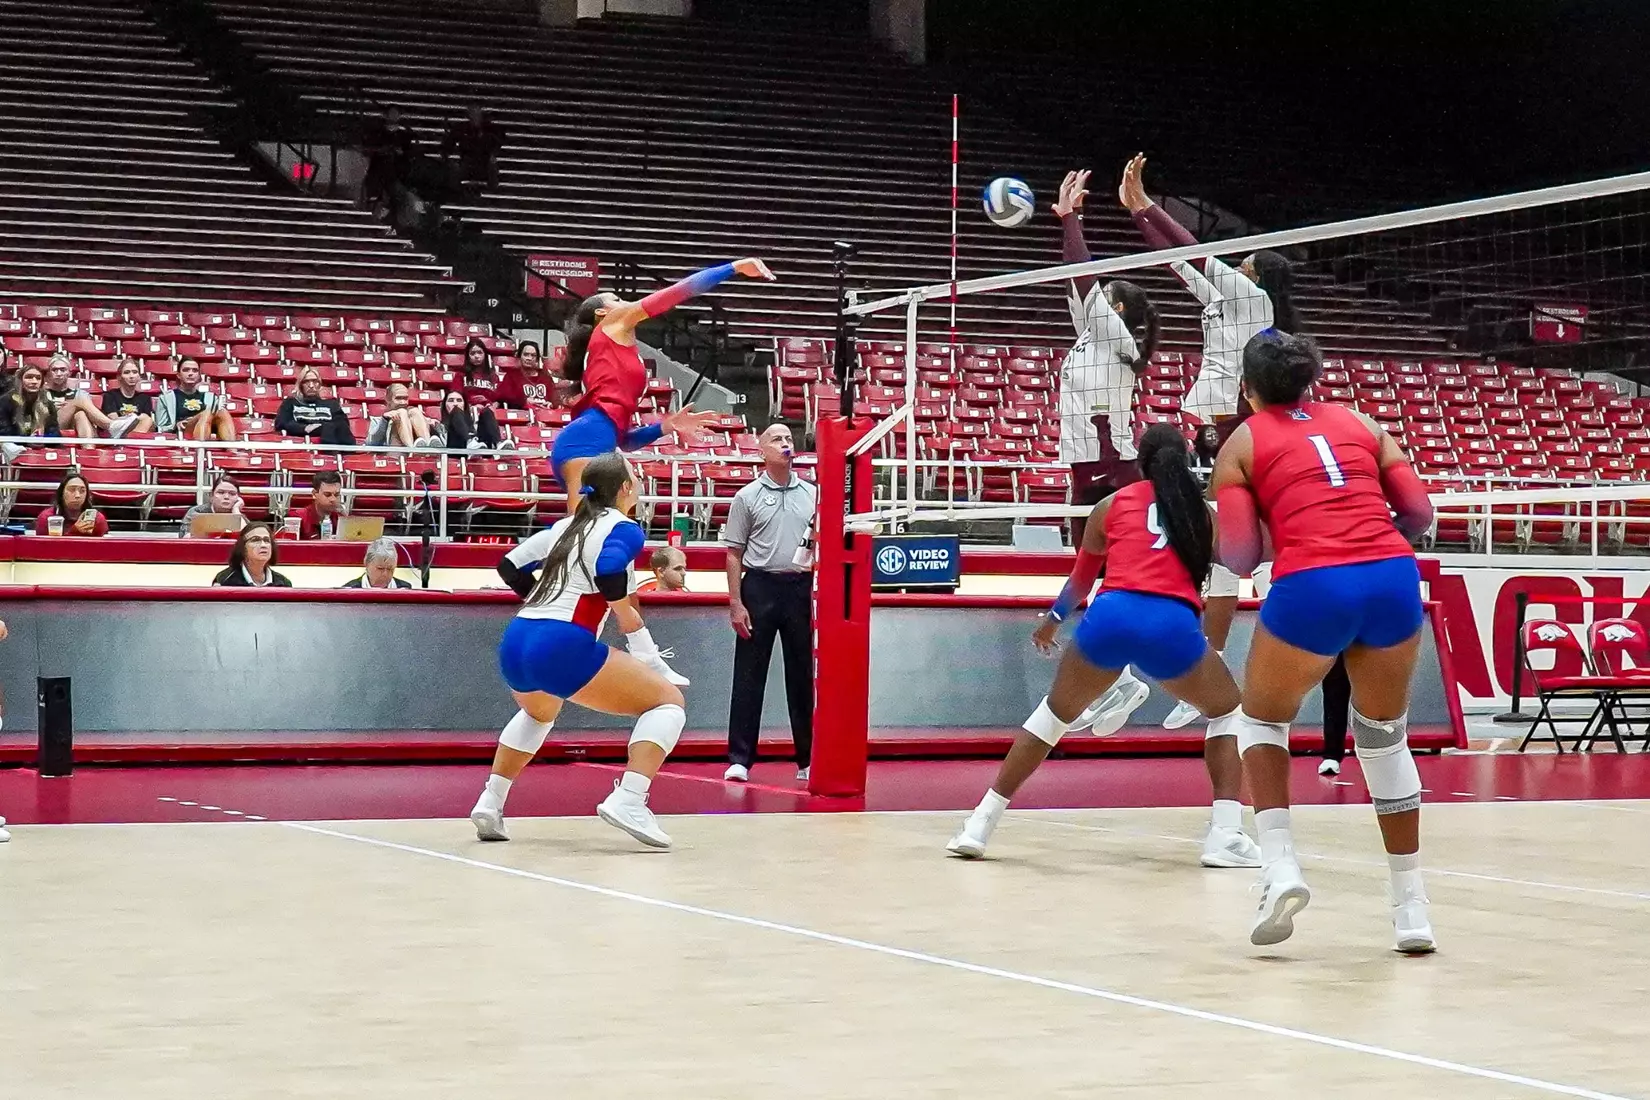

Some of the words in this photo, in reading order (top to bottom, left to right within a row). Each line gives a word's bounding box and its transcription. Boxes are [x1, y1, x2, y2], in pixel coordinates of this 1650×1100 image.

[539, 259, 587, 269] RESTROOMS
[462, 284, 476, 293] 20
[487, 298, 498, 307] 19
[512, 313, 523, 323] 18
[736, 393, 747, 404] 13
[1306, 433, 1346, 488] 1
[896, 523, 906, 534] 6
[909, 548, 949, 560] VIDEO
[879, 548, 904, 573] SEC
[909, 560, 950, 570] REVIEW
